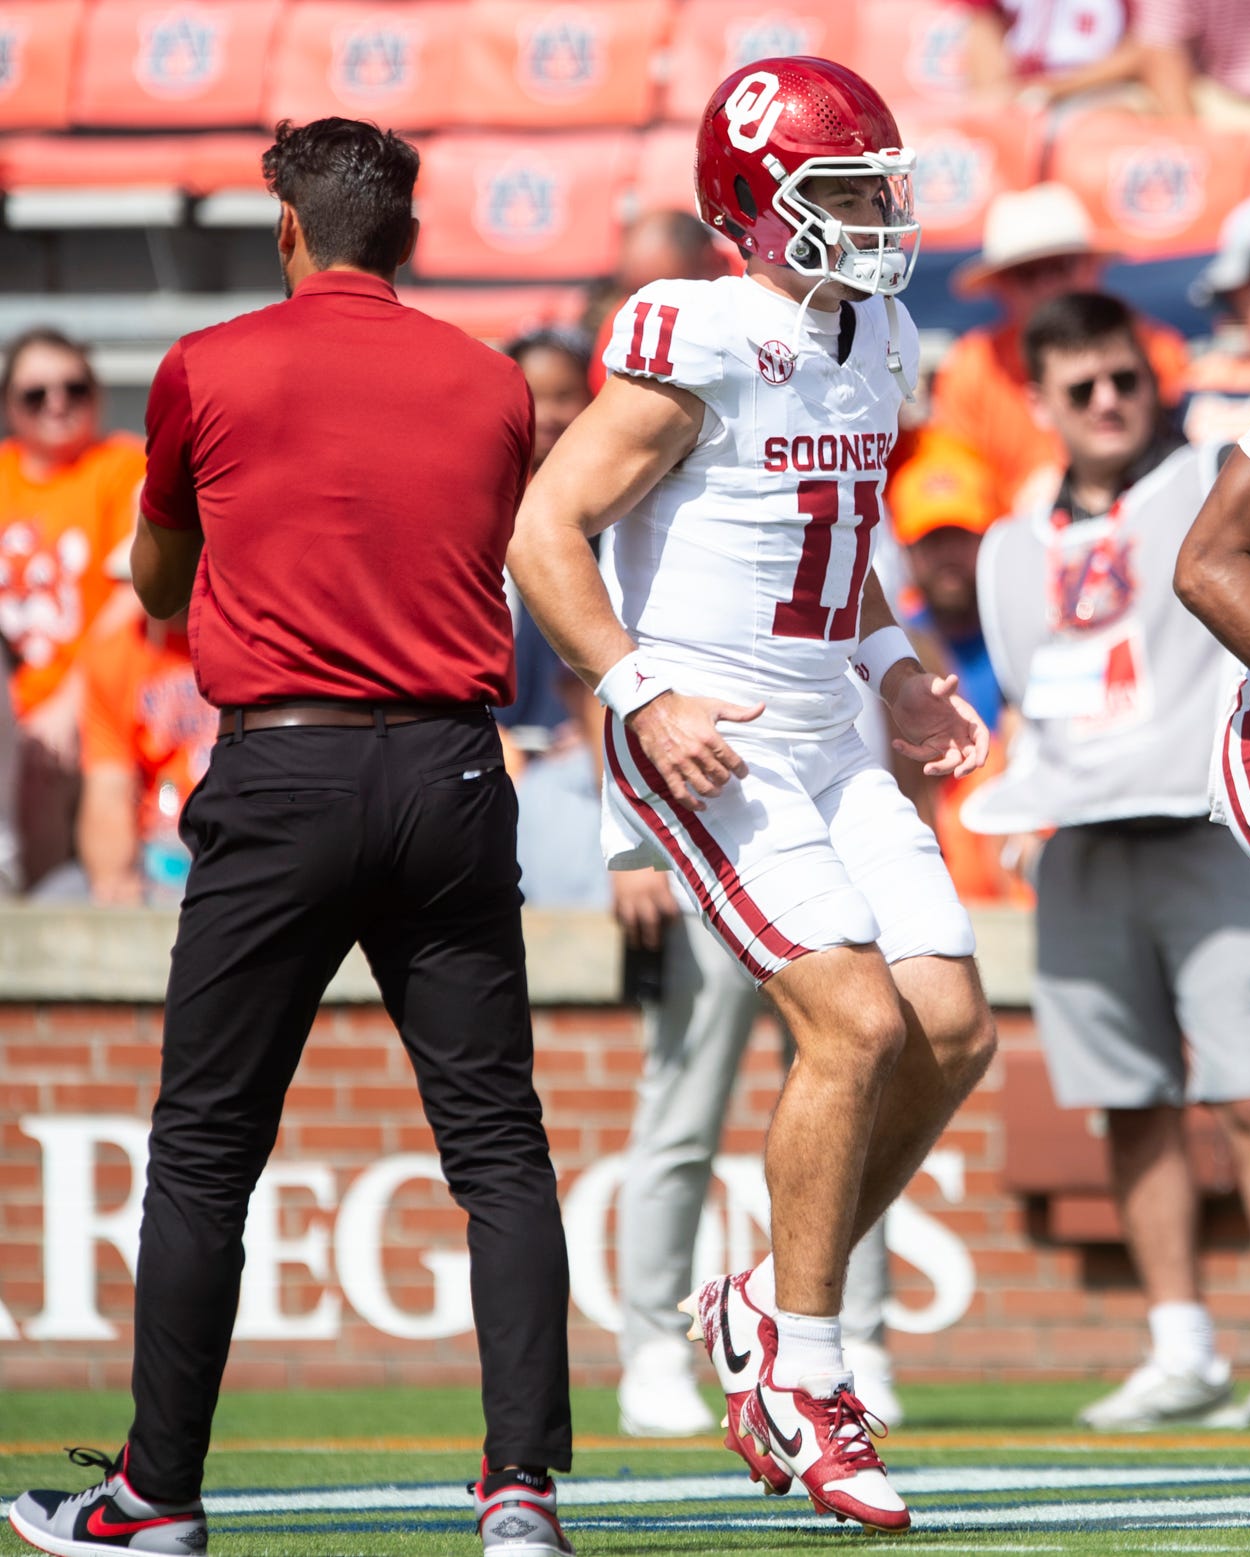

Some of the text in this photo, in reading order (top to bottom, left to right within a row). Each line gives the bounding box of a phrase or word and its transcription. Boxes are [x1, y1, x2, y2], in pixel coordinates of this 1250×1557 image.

[725, 71, 785, 153] OU
[625, 301, 679, 377] 11
[772, 480, 881, 642] 11
